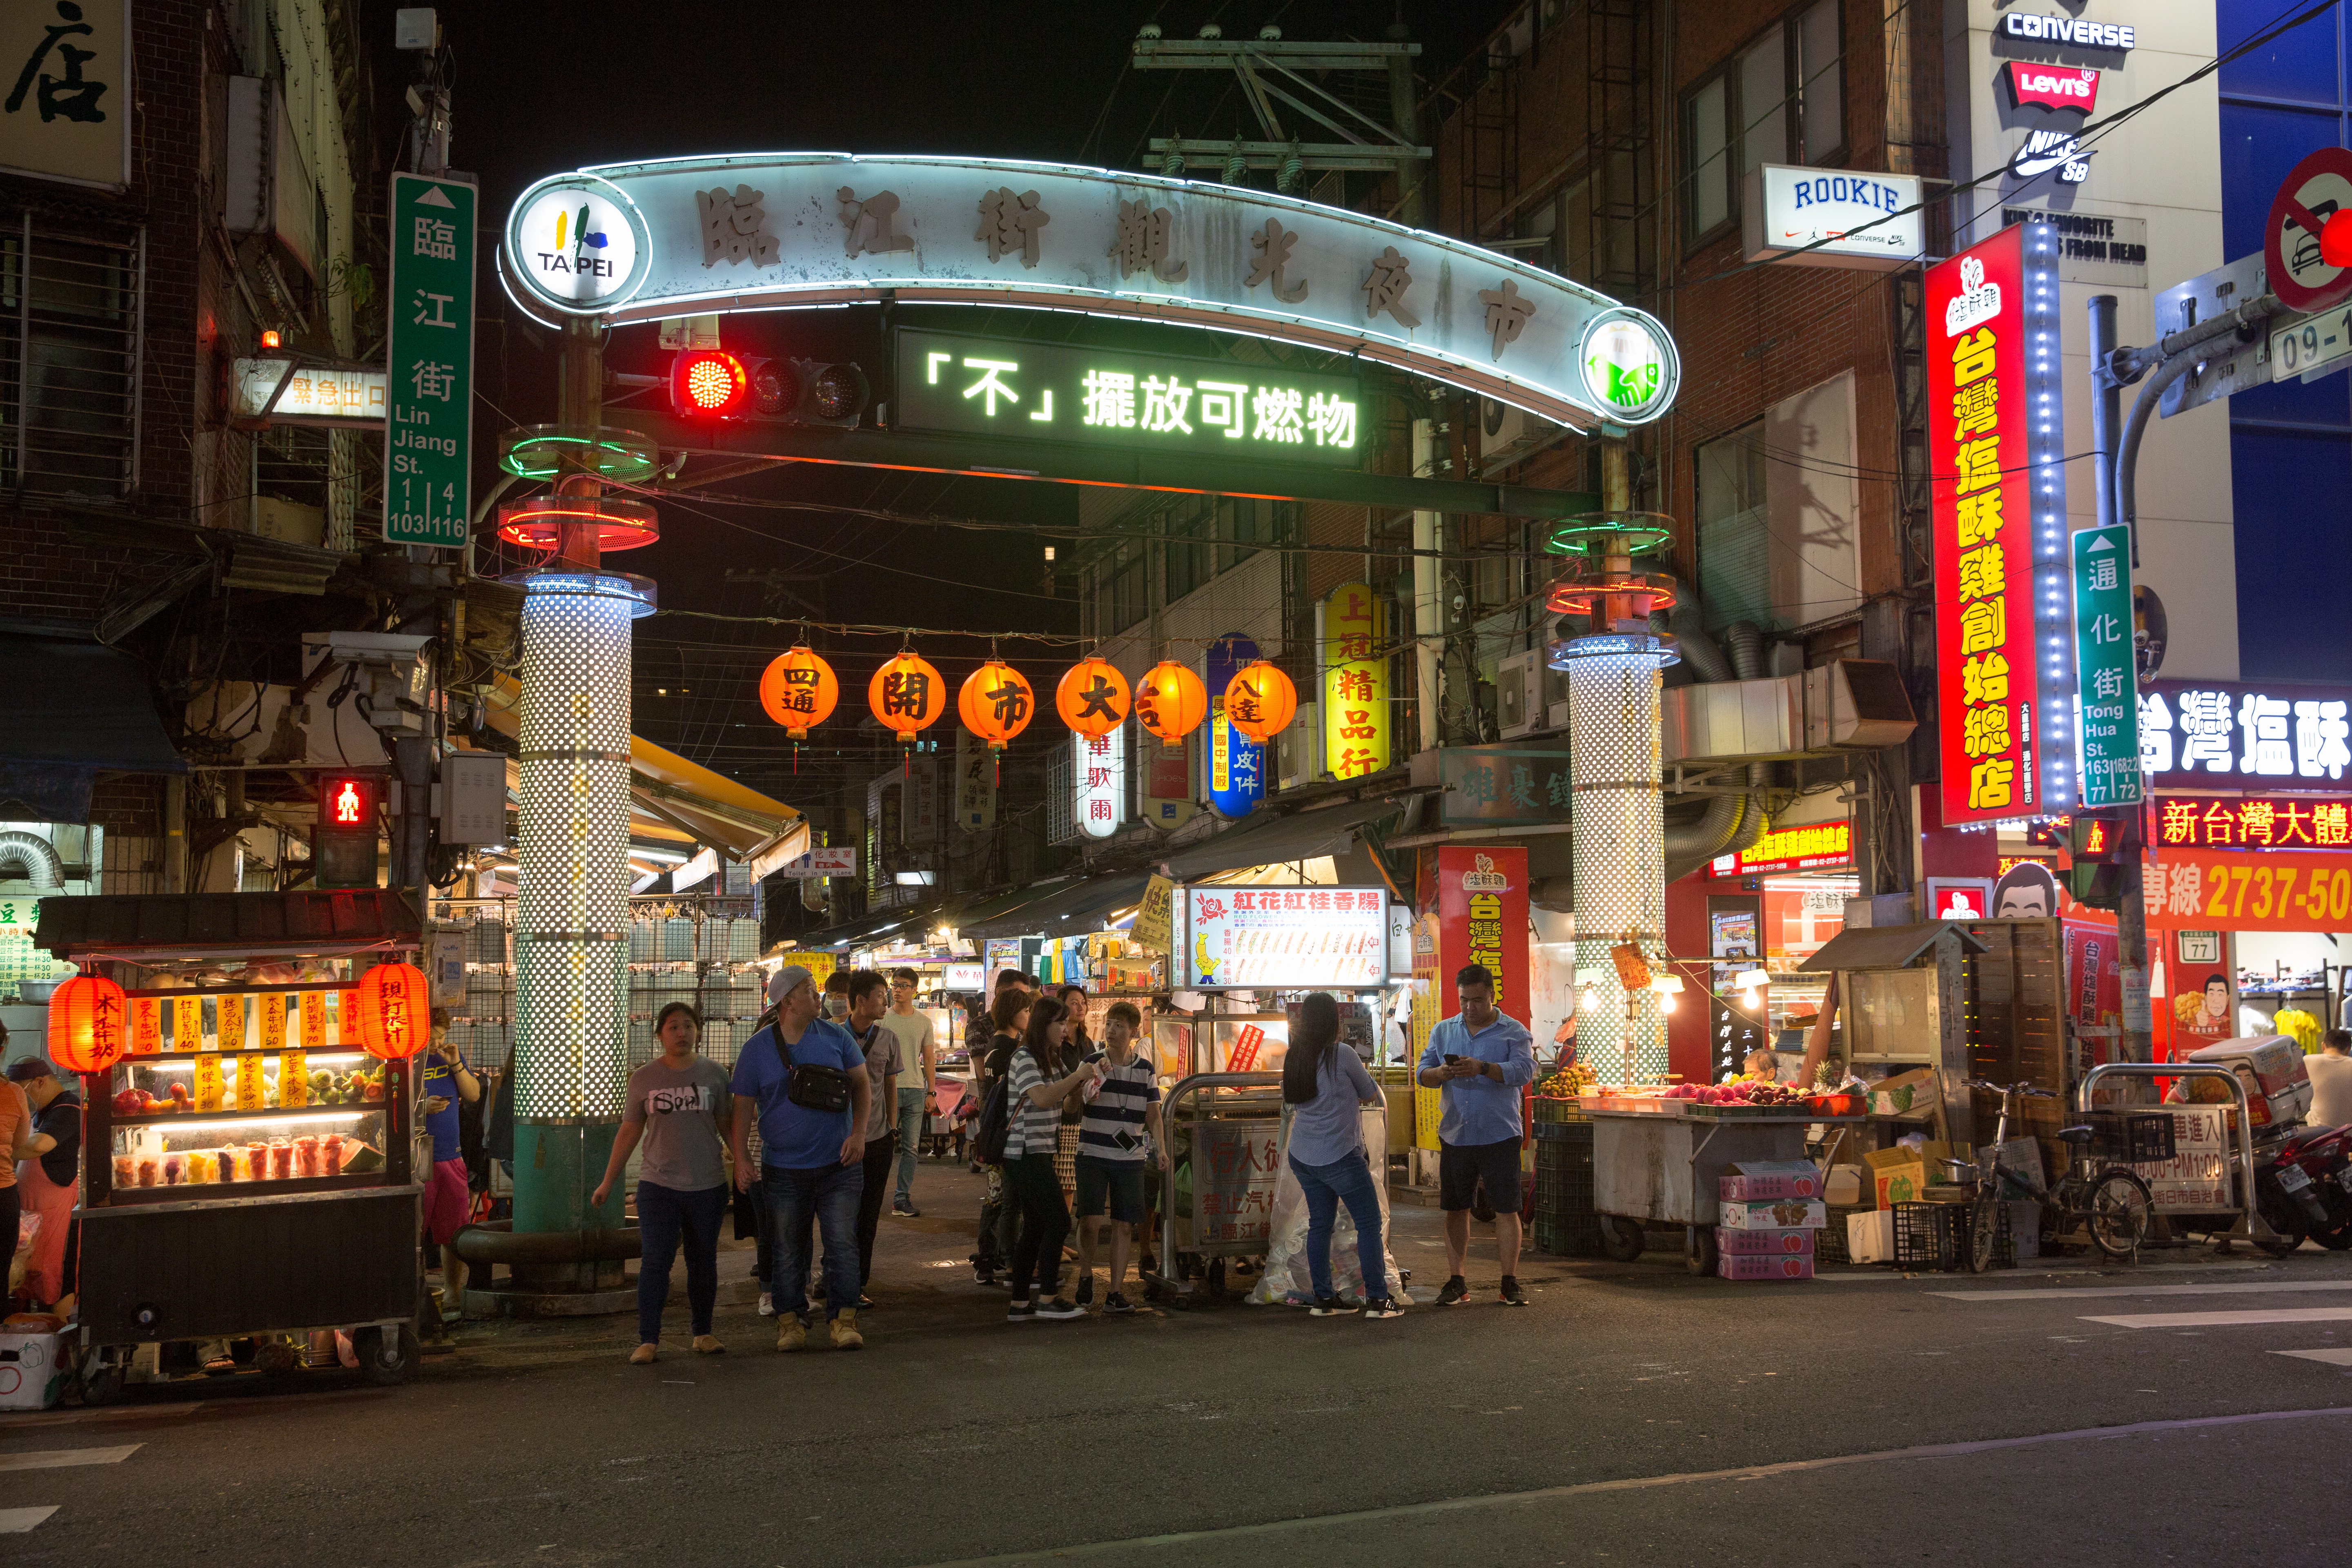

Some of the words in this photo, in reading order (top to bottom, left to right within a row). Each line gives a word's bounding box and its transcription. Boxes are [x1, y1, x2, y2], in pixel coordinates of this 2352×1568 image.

[2007, 12, 2134, 49] CONVERSE
[5, 0, 107, 123] 店
[2028, 130, 2080, 156] NIKE
[2063, 160, 2089, 183] SB
[1793, 176, 1900, 214] ROOKIE
[1851, 234, 1886, 243] CONVERSE
[2066, 238, 2107, 259] FROM
[2109, 242, 2146, 262] HEAD
[694, 183, 1537, 362] 臨江街觀光夜市
[411, 218, 457, 402] 臨江街
[293, 377, 385, 408] 緊急出口
[395, 404, 430, 425] Lin
[394, 430, 457, 457] Jiang
[394, 454, 423, 474] St.
[390, 512, 424, 534] 103
[432, 519, 465, 538] 116
[1951, 325, 2014, 811] 台灣塩酥雞創始總店
[2089, 558, 2123, 699] 通化街
[782, 668, 821, 714] 四通
[883, 671, 930, 721] 開
[1337, 593, 1379, 777] 上冠精品行
[985, 680, 1031, 731] 市
[1076, 675, 1122, 722] 大
[1230, 679, 1266, 724] 八達
[2084, 705, 2124, 719] Tong
[2085, 724, 2117, 738] Hua
[2086, 743, 2107, 757] St.
[1087, 735, 1112, 821] 華歌爾
[2086, 759, 2109, 775] 163
[2091, 786, 2107, 802] 77
[2119, 783, 2136, 800] 72
[2162, 800, 2352, 845] 新台灣大體
[815, 850, 851, 858] 化妝室
[1233, 891, 1380, 911] 紅花紅桂香腸
[2206, 865, 2352, 920] 2737-50
[1145, 914, 1159, 925] Happy
[1223, 929, 1232, 946] 香腸
[2192, 944, 2207, 958] 77
[1223, 958, 1232, 976] 米腸
[180, 1040, 194, 1049] 40
[265, 1036, 279, 1045] 50
[306, 1036, 318, 1045] 70
[287, 1054, 302, 1096] 芒果冰沙
[243, 1102, 255, 1110] 50
[286, 1097, 300, 1106] 50
[2128, 1189, 2225, 1206] 臨街日市自治會
